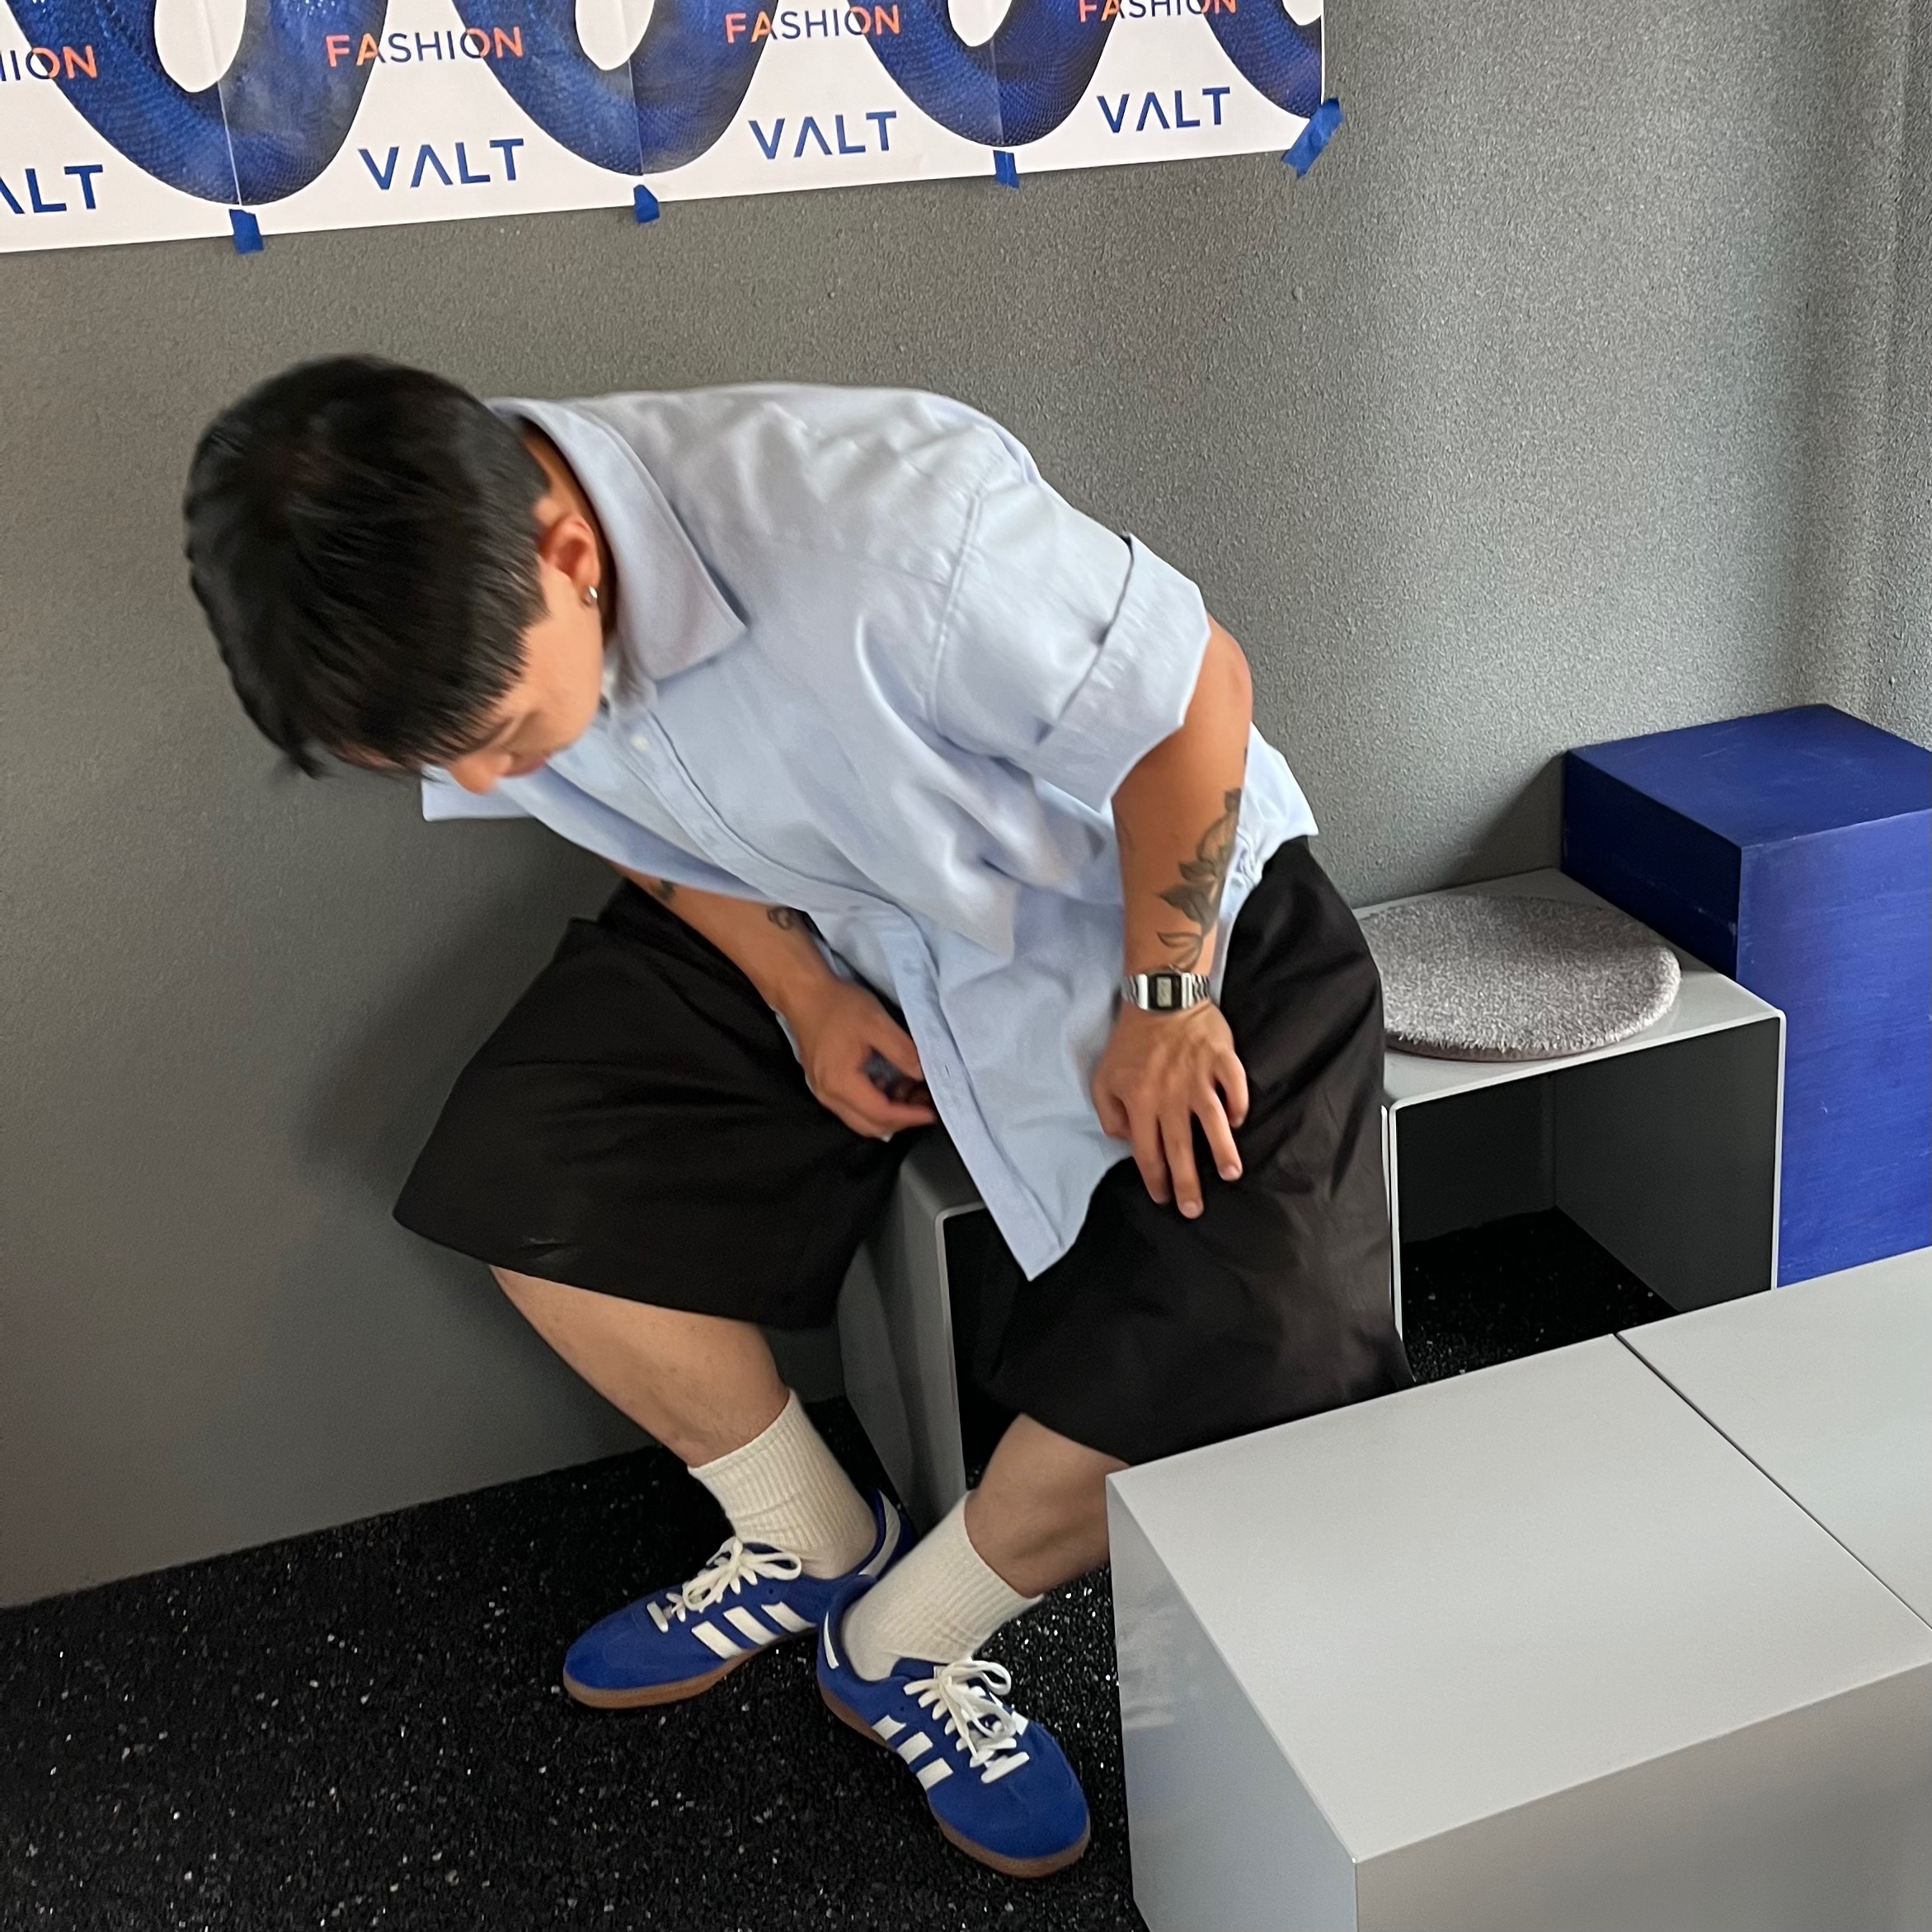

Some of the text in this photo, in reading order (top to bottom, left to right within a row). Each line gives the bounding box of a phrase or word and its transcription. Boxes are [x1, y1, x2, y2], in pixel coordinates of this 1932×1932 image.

[326, 26, 524, 67] FASHION
[725, 4, 900, 44] FASHION
[1096, 86, 1231, 134] VALT
[748, 110, 896, 159] VALT
[358, 138, 524, 190] VALT
